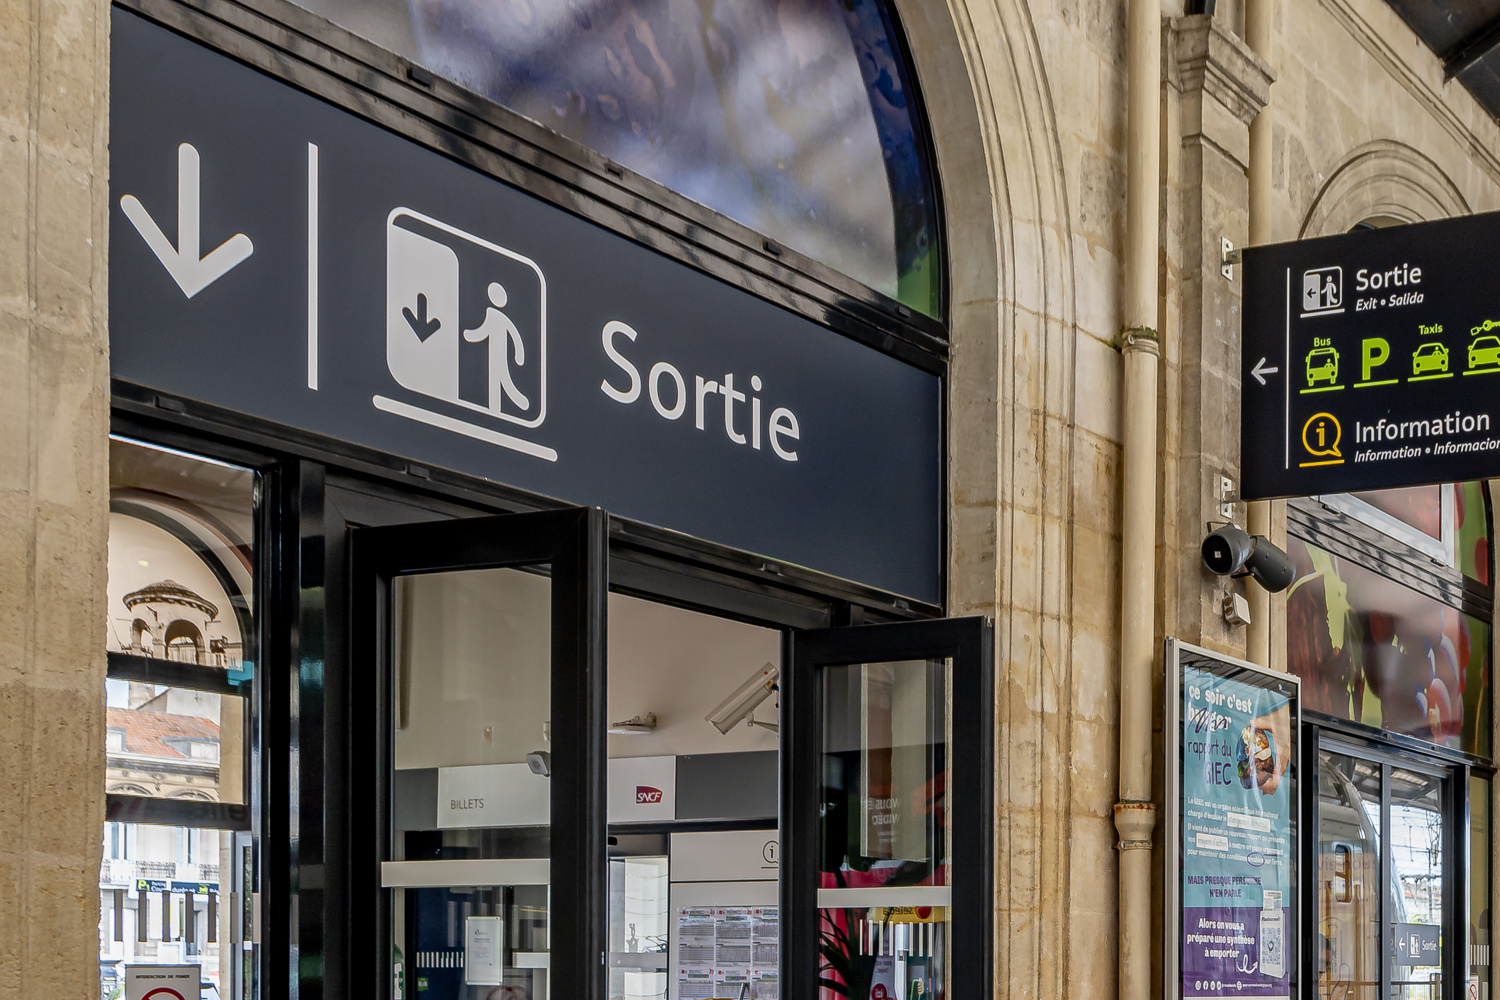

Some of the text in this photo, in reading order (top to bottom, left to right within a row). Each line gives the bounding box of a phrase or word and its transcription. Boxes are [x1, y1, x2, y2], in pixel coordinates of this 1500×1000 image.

[1356, 263, 1422, 291] Sortie
[1356, 291, 1425, 312] Exit Salida
[1418, 323, 1444, 336] Taxis
[1313, 337, 1332, 347] Bus
[1362, 337, 1390, 381] P
[600, 320, 800, 462] Sortie
[1356, 411, 1490, 443] Information
[1354, 446, 1422, 463] Information
[1188, 685, 1253, 714] ce soir c'est
[1188, 739, 1231, 761] rapport du
[1204, 761, 1232, 785] GIEC
[450, 798, 485, 810] BILLETS
[637, 792, 662, 802] SNCF
[1187, 875, 1204, 885] MAIS
[1205, 876, 1231, 886] PRESQUE
[1209, 888, 1242, 898] N'EN PARLE
[1198, 917, 1245, 931] Alors on vous a
[1187, 932, 1255, 946] préparé une synthèse
[1421, 939, 1437, 953] Sortie
[1204, 947, 1239, 960] à emporter
